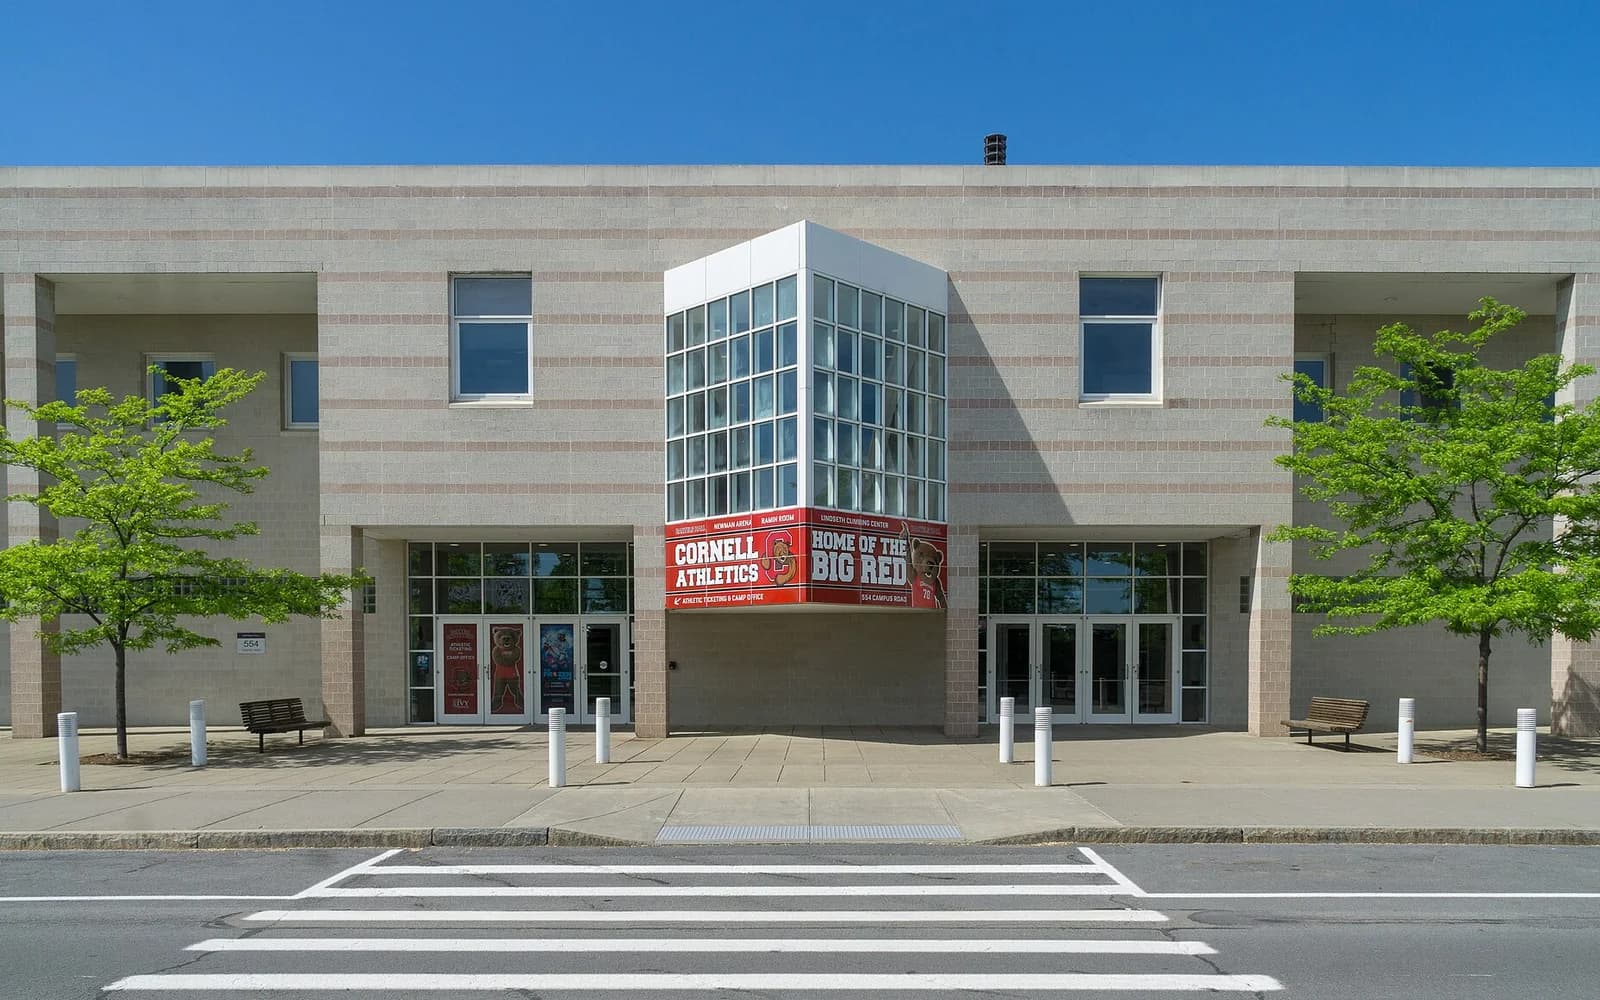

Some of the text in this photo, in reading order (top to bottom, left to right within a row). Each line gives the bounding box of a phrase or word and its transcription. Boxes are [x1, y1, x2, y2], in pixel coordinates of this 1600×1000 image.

[736, 520, 752, 528] ARENA
[761, 514, 795, 524] RAMIN ROOM
[820, 514, 889, 528] LINDSETH CLIMBING CENTER
[674, 536, 758, 566] CORNELL
[812, 530, 907, 556] HOME OF THE
[676, 564, 758, 588] ATHLETICS
[811, 550, 907, 586] BIG RED
